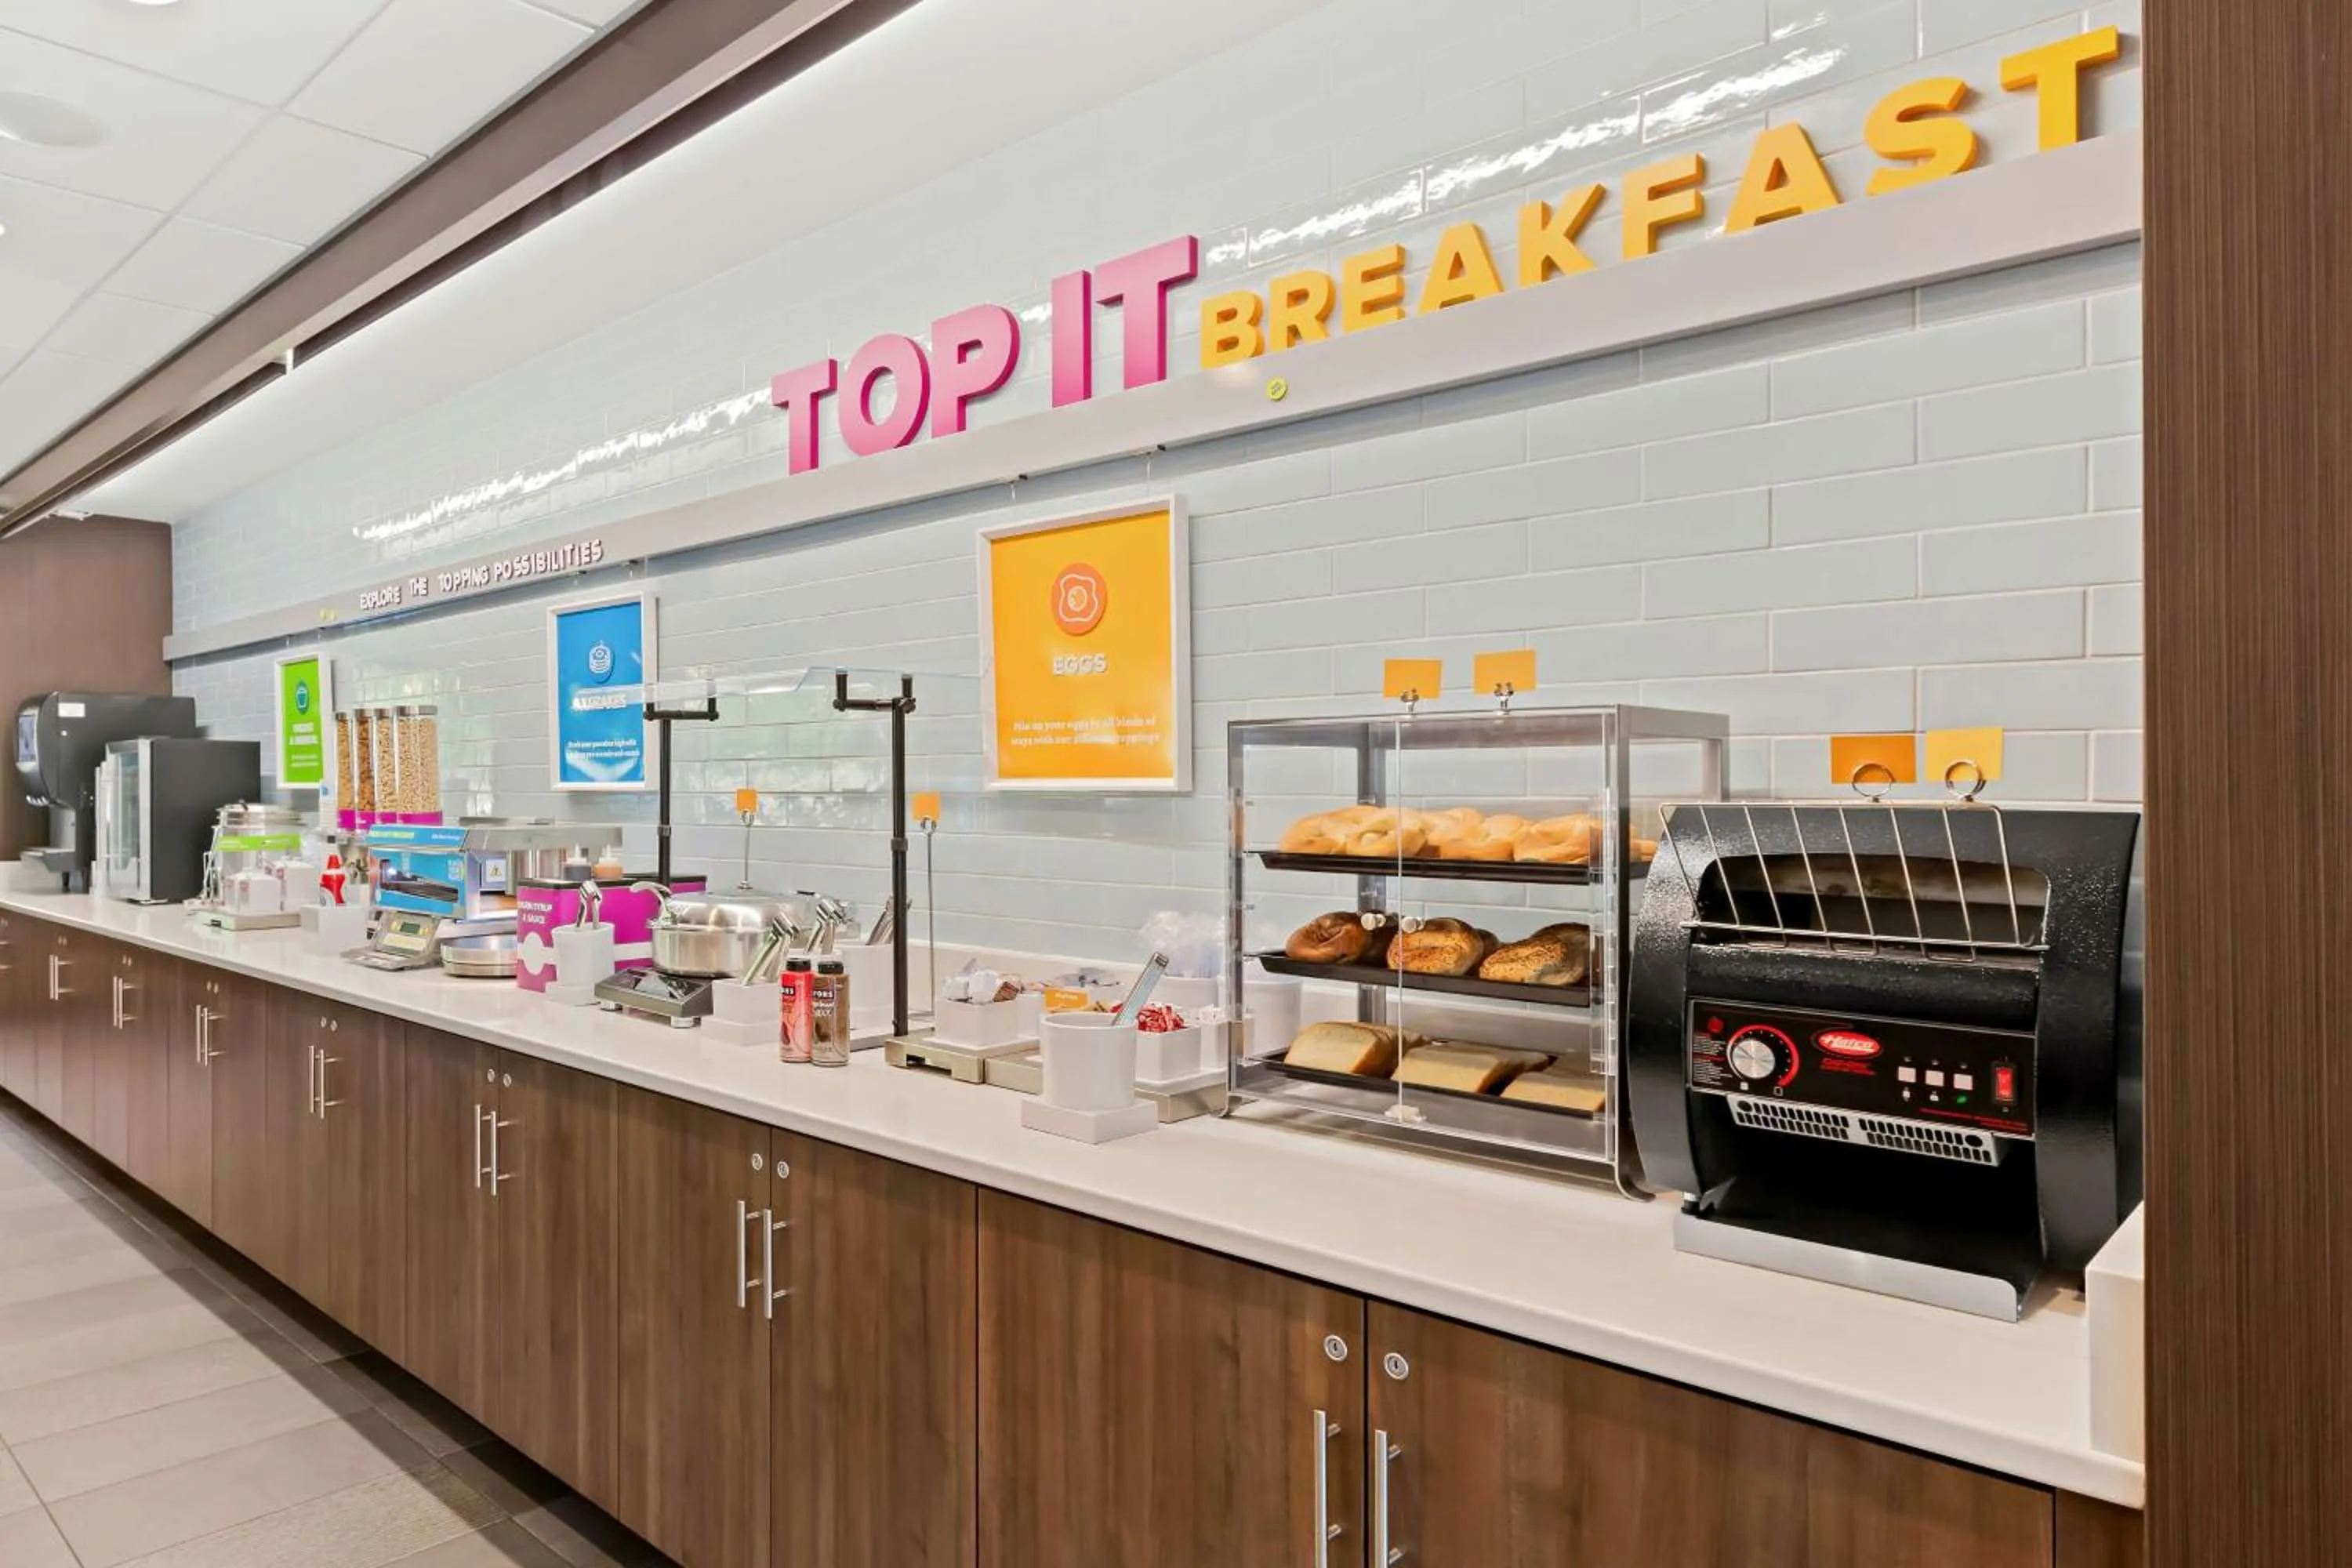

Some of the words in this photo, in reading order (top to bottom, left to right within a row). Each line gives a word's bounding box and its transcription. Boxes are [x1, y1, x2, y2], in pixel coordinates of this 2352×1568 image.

[771, 303, 1020, 475] TOP
[1051, 234, 1199, 408] IT
[1200, 25, 2120, 371] BREAKFAST
[360, 586, 402, 610] EXPLORE
[409, 576, 428, 597] THE
[438, 564, 490, 592] TOPPING
[494, 539, 604, 582] POSSIBILITIES
[1053, 653, 1108, 676] EGGS
[1820, 1034, 1875, 1052] Hatco
